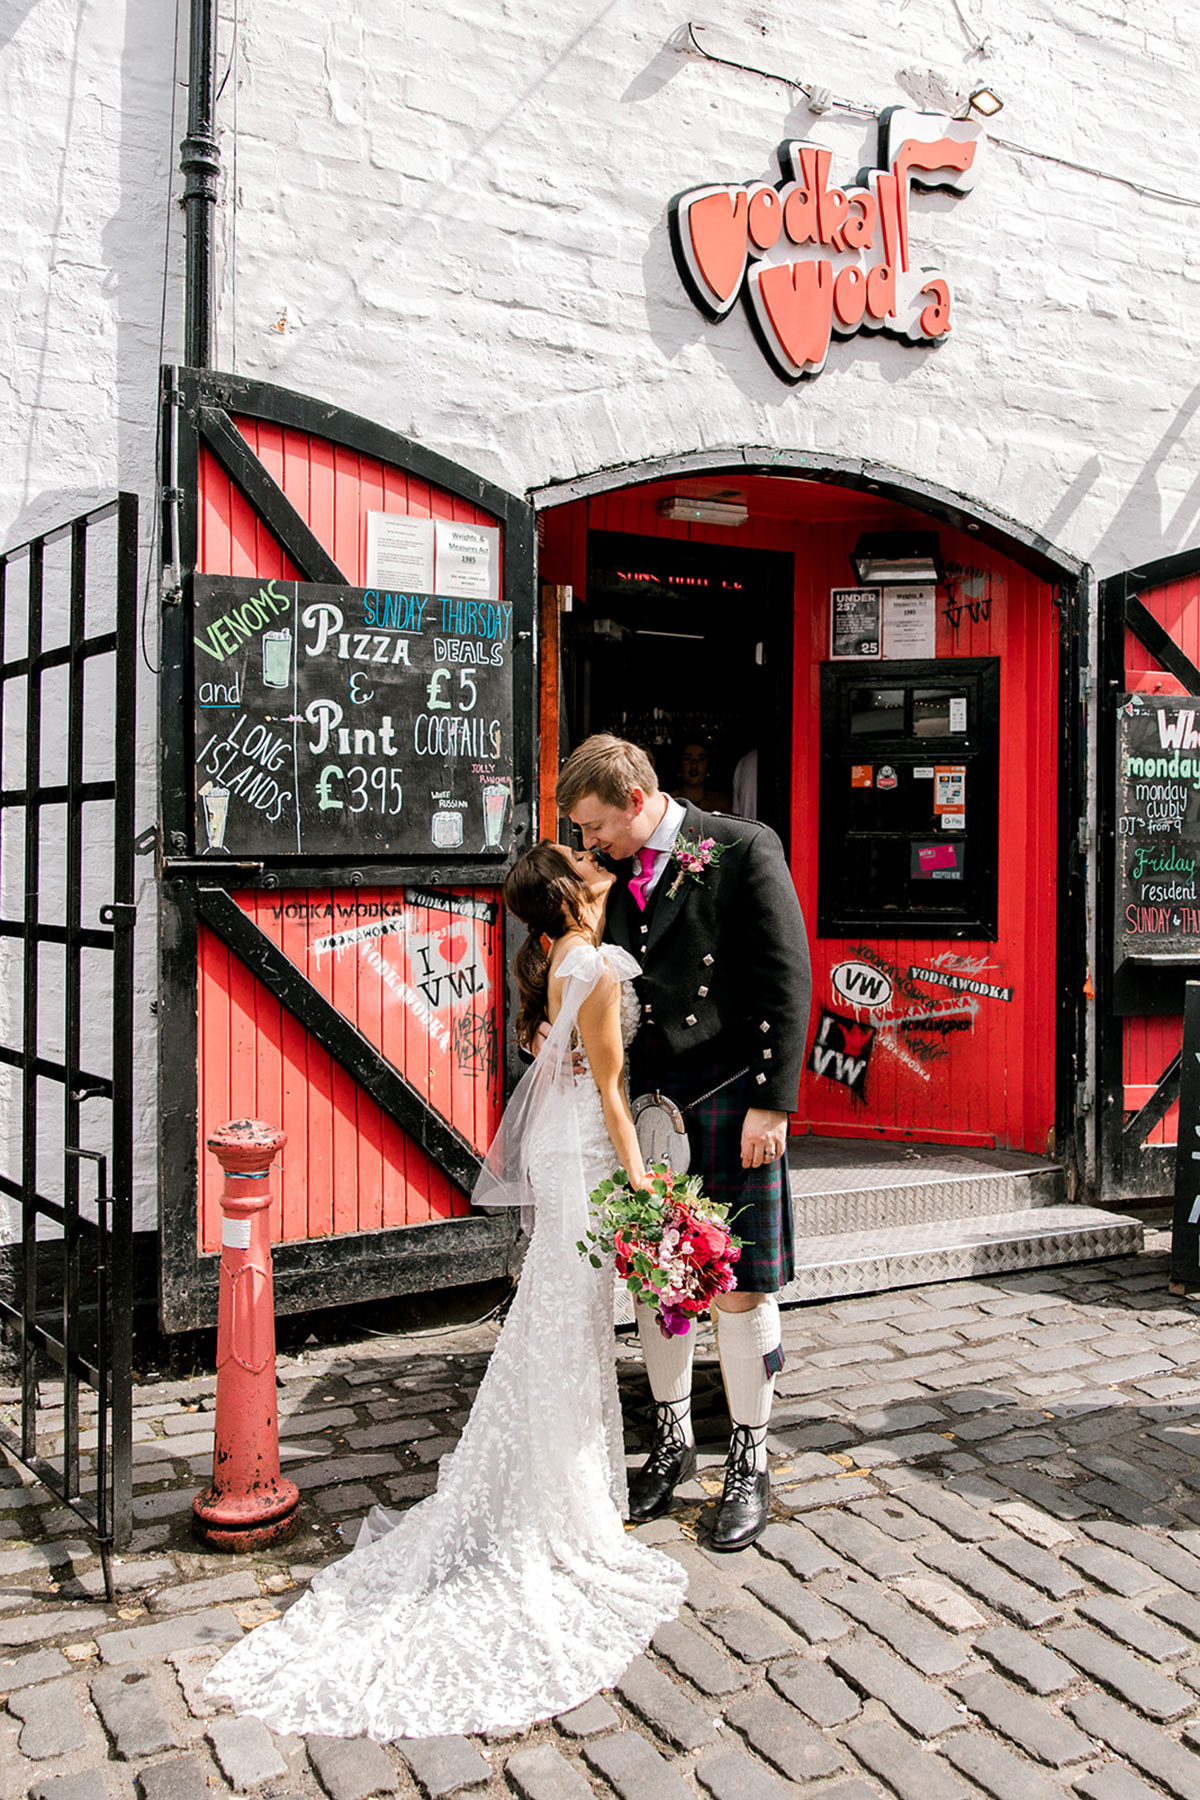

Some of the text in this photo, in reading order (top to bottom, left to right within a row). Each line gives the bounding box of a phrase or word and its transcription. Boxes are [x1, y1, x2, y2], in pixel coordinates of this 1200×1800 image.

[836, 593, 876, 603] UNDER
[836, 603, 856, 611] 25?
[942, 598, 992, 630] VW
[194, 579, 290, 662] VENOMS
[363, 590, 428, 631] SUNDAY
[438, 598, 513, 641] THURSDAY
[434, 638, 504, 666] DEALS
[861, 642, 877, 653] 25
[199, 672, 240, 703] and
[350, 672, 374, 704] &
[426, 668, 477, 711] £5
[226, 714, 291, 771] LONG
[1157, 708, 1200, 749] Wh
[196, 734, 291, 821] ISLANDS
[472, 764, 495, 773] JOLLY
[315, 765, 402, 814] £3.95
[439, 799, 468, 808] RUSSIAN
[1136, 780, 1187, 812] monday
[1147, 819, 1171, 835] from
[1133, 845, 1197, 886] Friday
[1141, 880, 1197, 902] resident
[1125, 903, 1171, 934] SUNDAY
[417, 946, 435, 977] I
[358, 943, 451, 1054] VODKAWODKA
[845, 968, 883, 1000] VW
[911, 966, 1009, 1001] VODKAWODKA
[813, 1046, 867, 1086] VW
